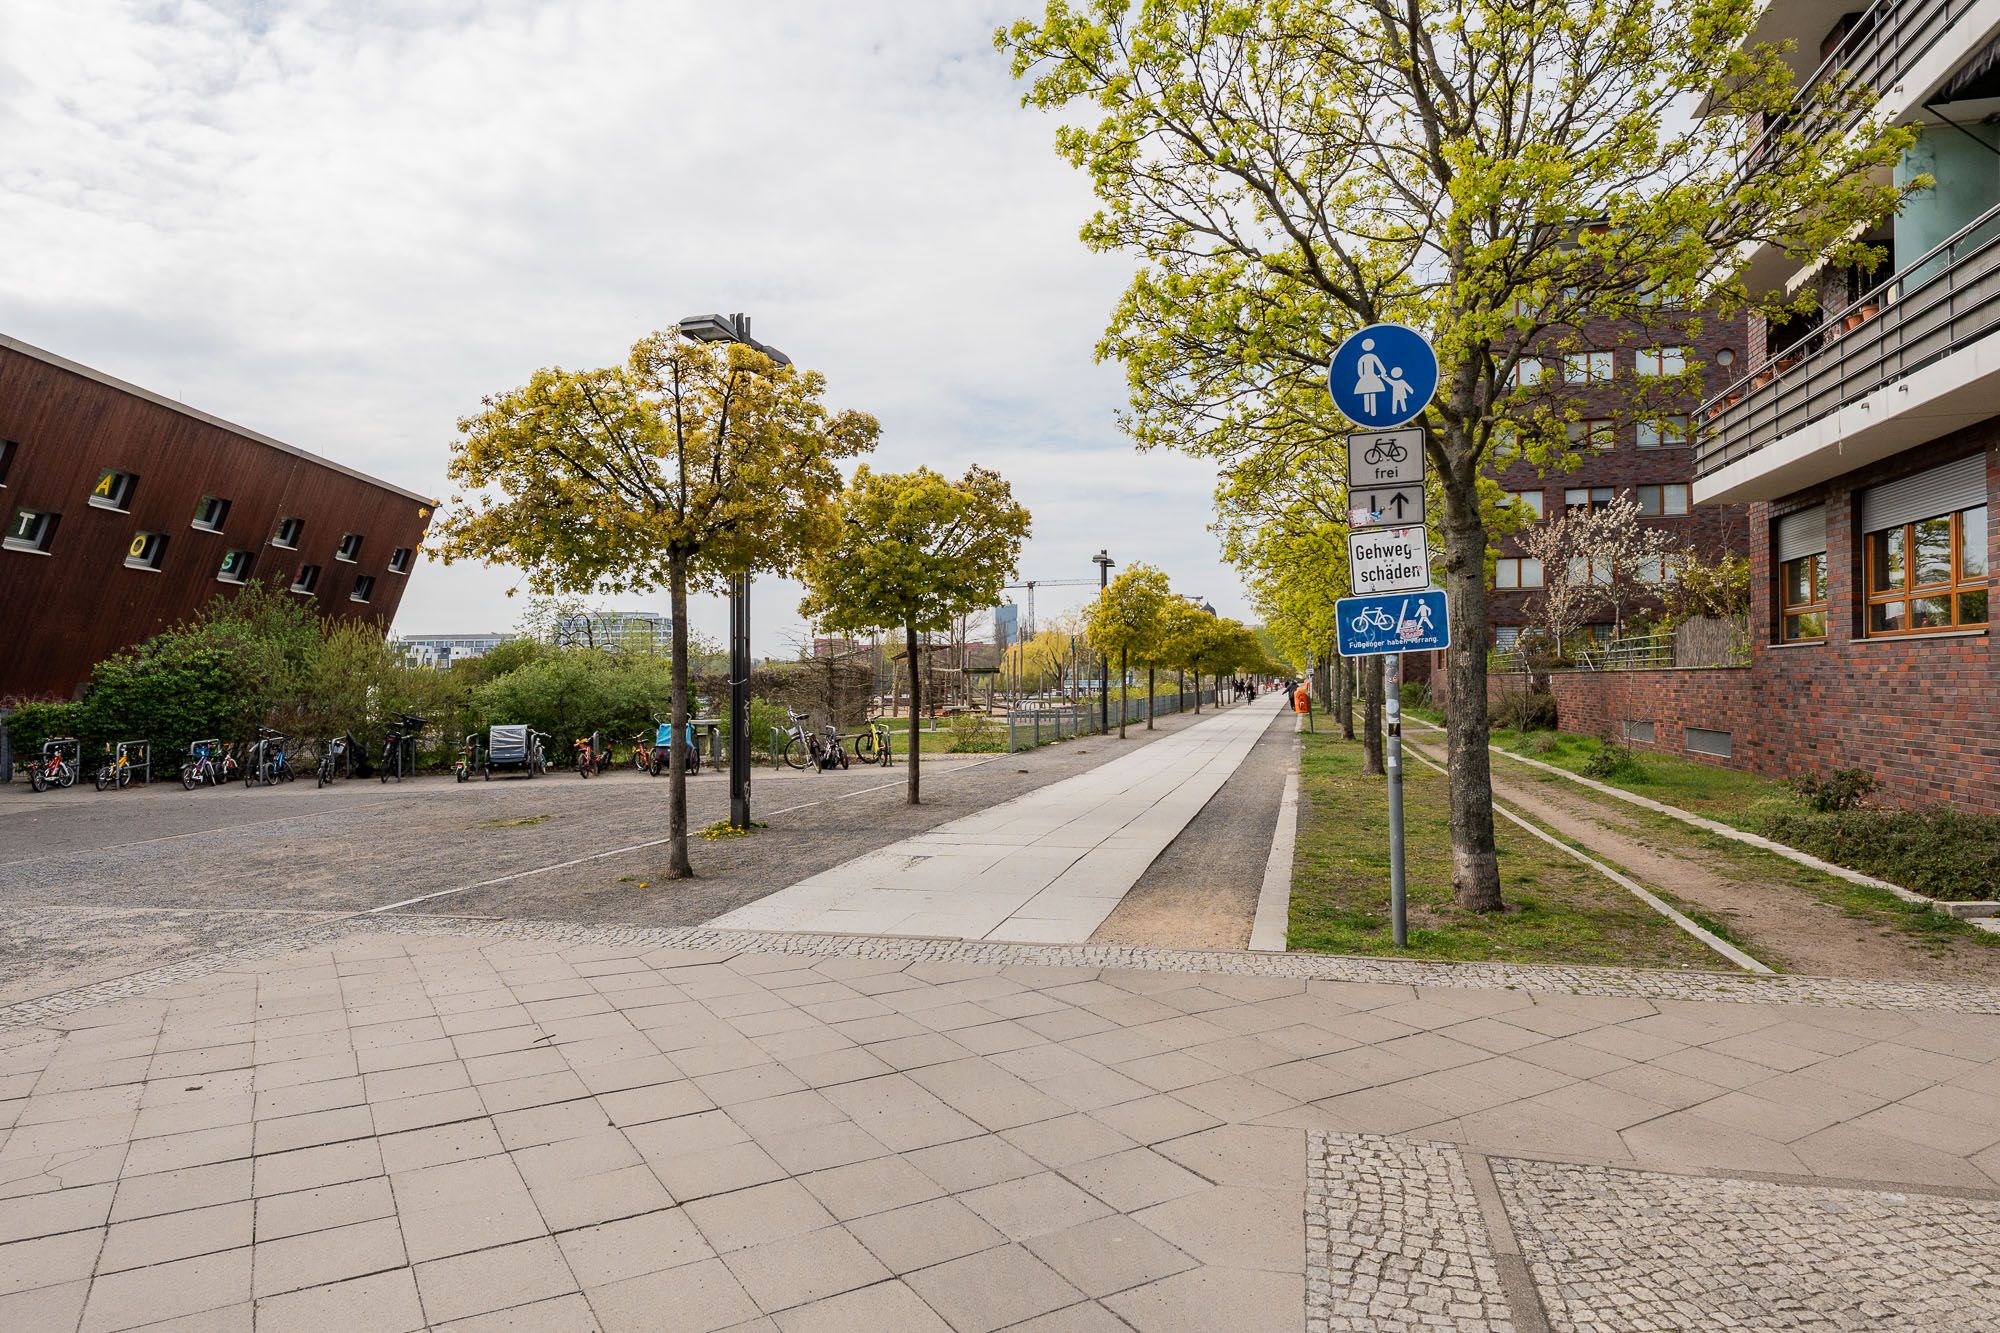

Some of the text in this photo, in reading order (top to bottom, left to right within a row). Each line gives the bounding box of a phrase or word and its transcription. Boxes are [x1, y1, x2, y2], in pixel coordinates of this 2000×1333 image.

[1375, 466, 1399, 479] frei
[95, 474, 112, 495] A
[19, 511, 36, 535] T
[1356, 543, 1412, 560] Gehweg
[1361, 563, 1421, 582] schäden
[1386, 638, 1408, 646] haben
